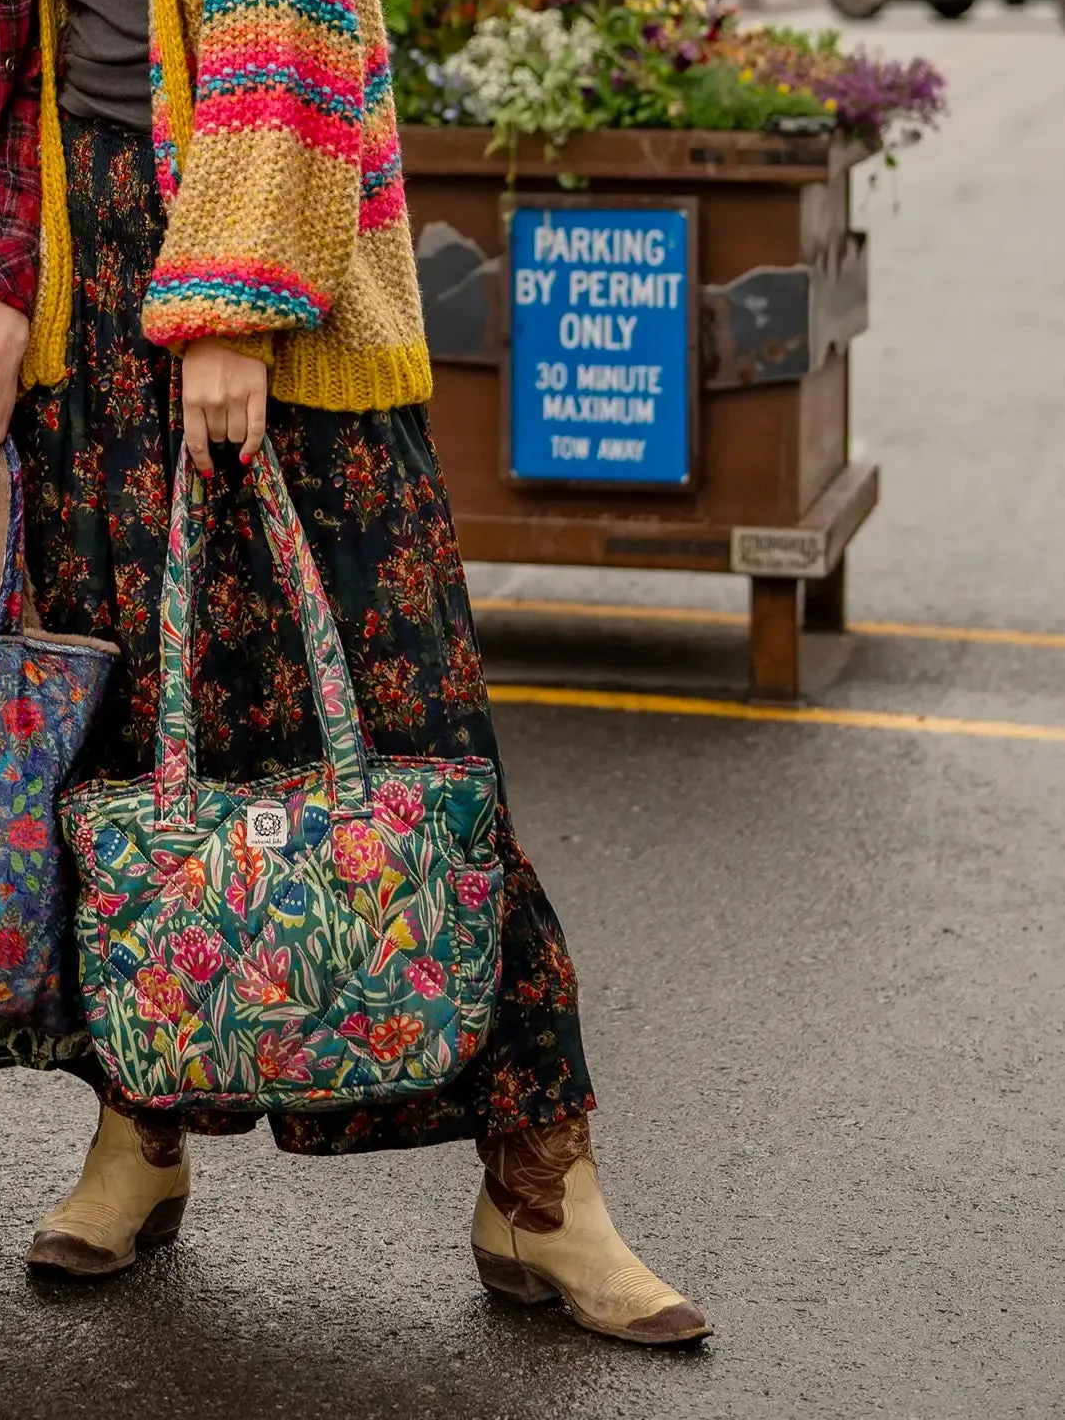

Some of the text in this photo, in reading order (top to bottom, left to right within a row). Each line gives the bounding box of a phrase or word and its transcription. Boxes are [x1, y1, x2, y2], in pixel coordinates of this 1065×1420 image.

[535, 227, 665, 266] PARKING
[516, 269, 682, 309] BY PERMIT
[559, 313, 637, 350] ONLY
[535, 362, 663, 394] 30 MINUTE
[542, 395, 655, 424] MAXIMUM
[550, 436, 647, 462] TOW AWAY
